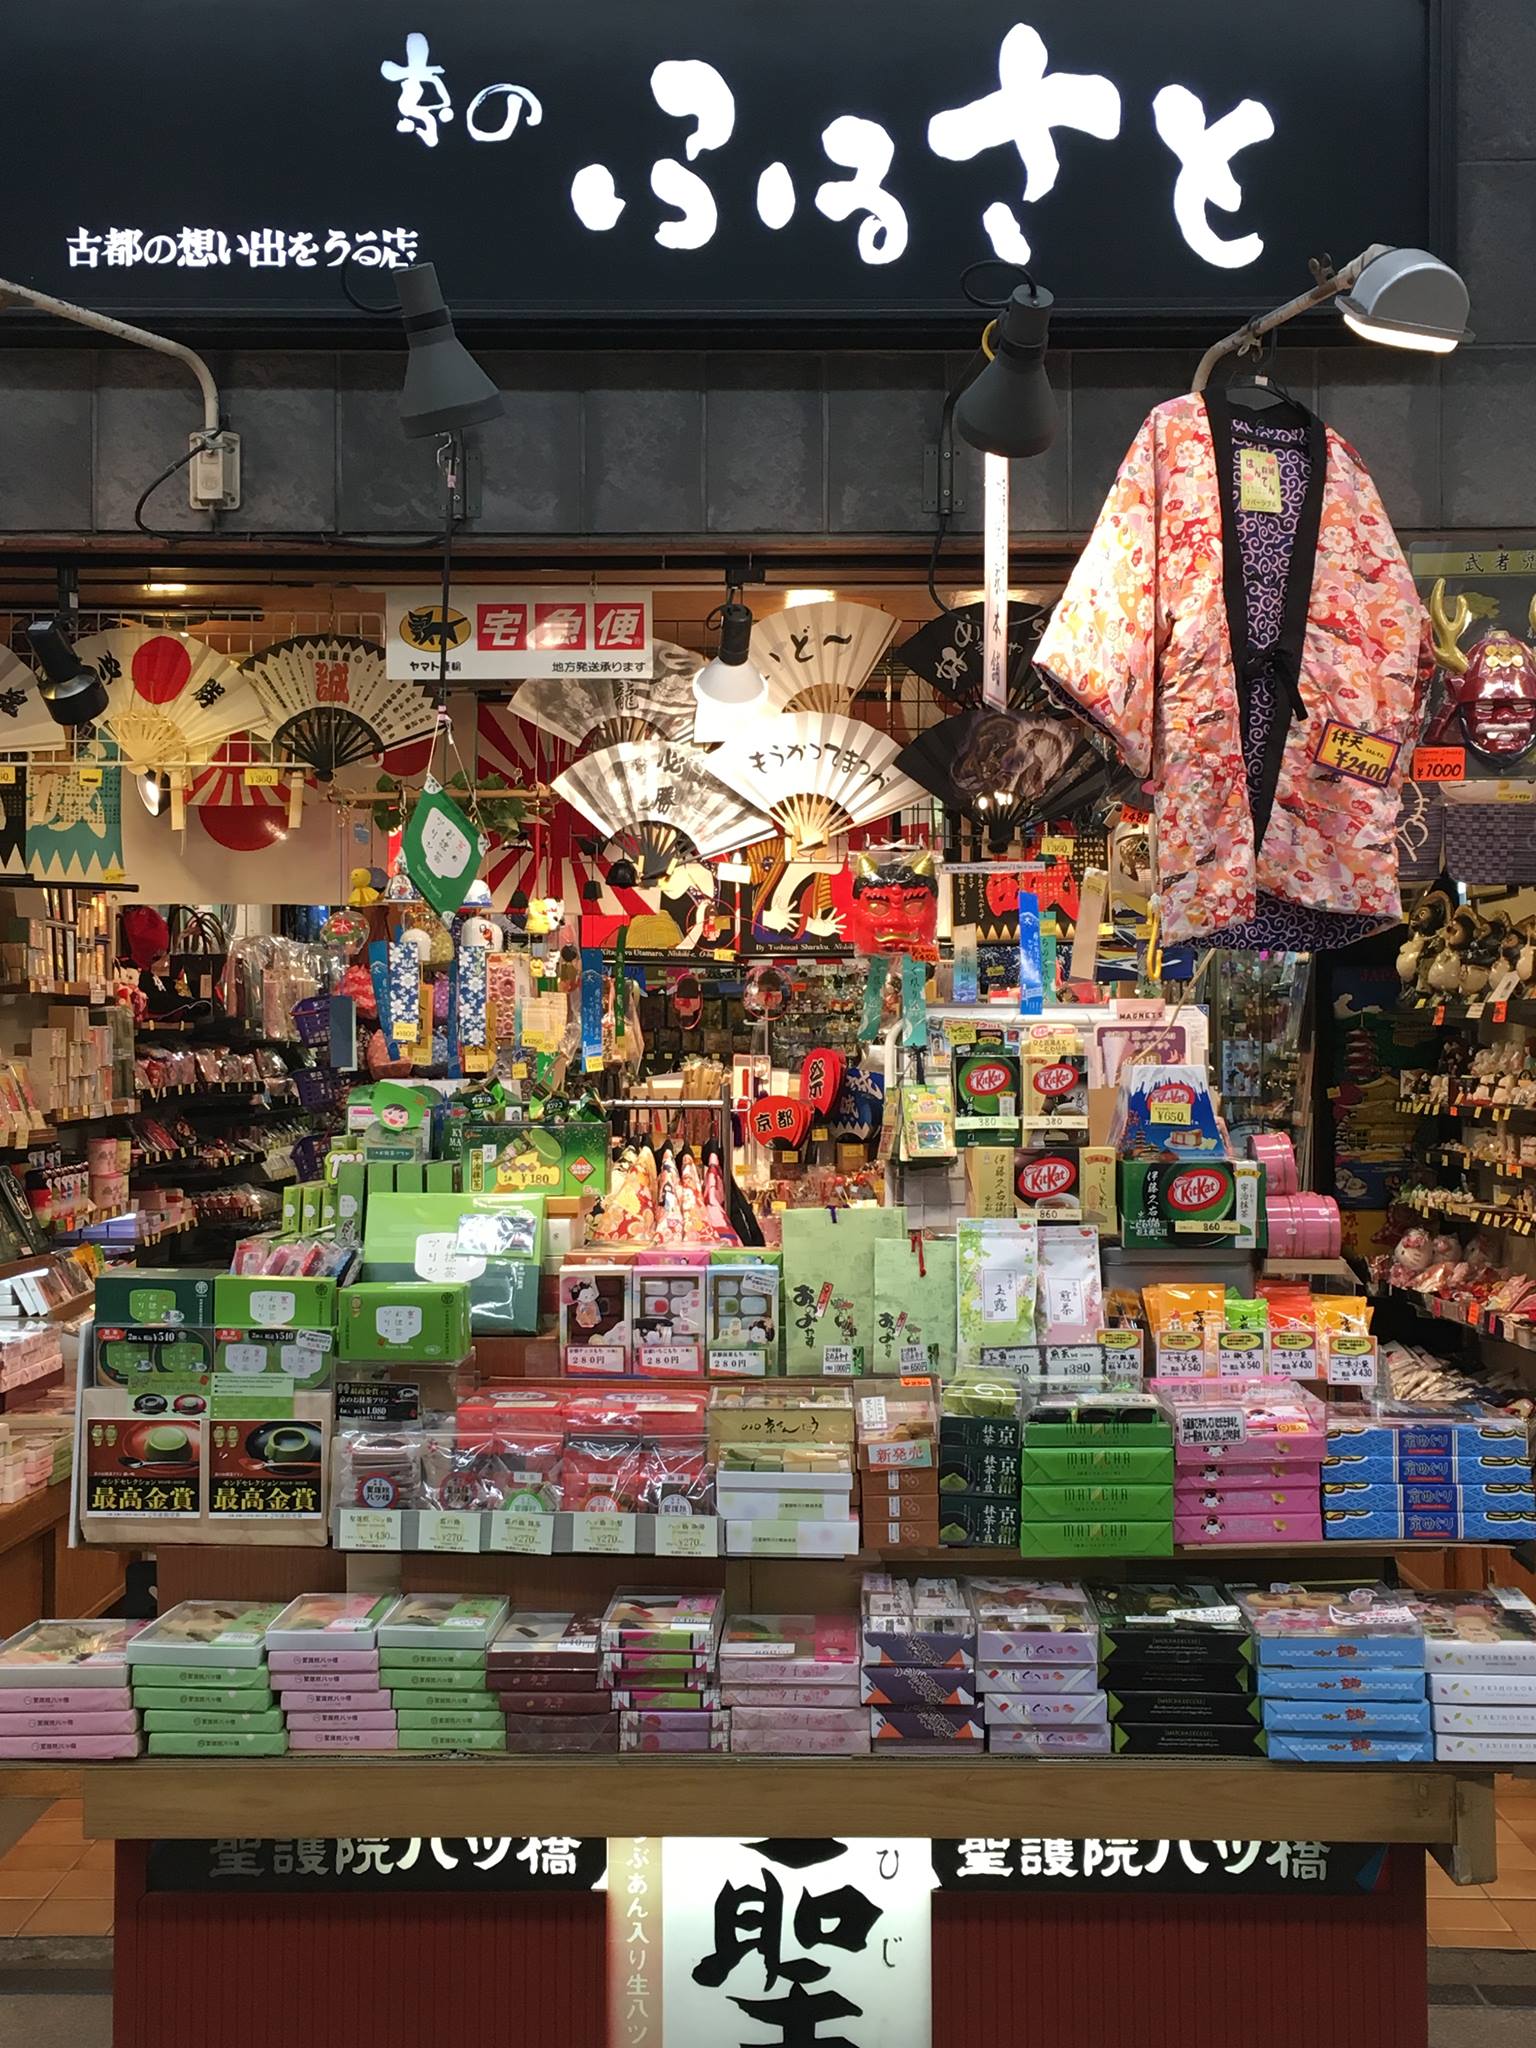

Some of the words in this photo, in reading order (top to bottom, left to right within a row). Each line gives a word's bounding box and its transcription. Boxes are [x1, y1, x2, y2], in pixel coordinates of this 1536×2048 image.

[571, 22, 1275, 269] ふるさと
[482, 608, 640, 647] 宅急便
[552, 661, 645, 673] 地方発送承ります
[749, 743, 891, 791] もうかってまっか
[1334, 749, 1388, 783] ¥2400
[1119, 1011, 1163, 1020] MAGNETS
[808, 1057, 826, 1099] 祭
[974, 1070, 1003, 1091] KitKat
[1043, 1069, 1070, 1090] KitKat
[755, 1108, 795, 1133] 京都
[978, 1117, 996, 1127] 380
[1045, 1117, 1063, 1126] 380
[1031, 1165, 1067, 1191] KitKat
[1180, 1177, 1216, 1204] KitKat
[1039, 1209, 1058, 1219] 860
[1203, 1222, 1221, 1232] 860
[992, 1284, 1007, 1312] 玉露
[1059, 1289, 1074, 1316] 煎茶
[572, 1355, 605, 1365] 280円
[647, 1355, 679, 1365] 280円
[714, 1359, 747, 1368] 280円
[1403, 1433, 1449, 1448] 京めぐり
[876, 1445, 924, 1463] 新発売
[983, 1455, 998, 1494] 抹茶小豆
[998, 1455, 1017, 1495] 京都
[1403, 1460, 1449, 1476] 京めぐり
[92, 1486, 196, 1511] 最高金賞
[214, 1487, 318, 1511] 最高金賞
[1407, 1488, 1454, 1504] 京めぐり
[983, 1505, 998, 1545] 抹茶小豆
[998, 1506, 1017, 1545] 京都
[1408, 1515, 1455, 1531] 京めぐり
